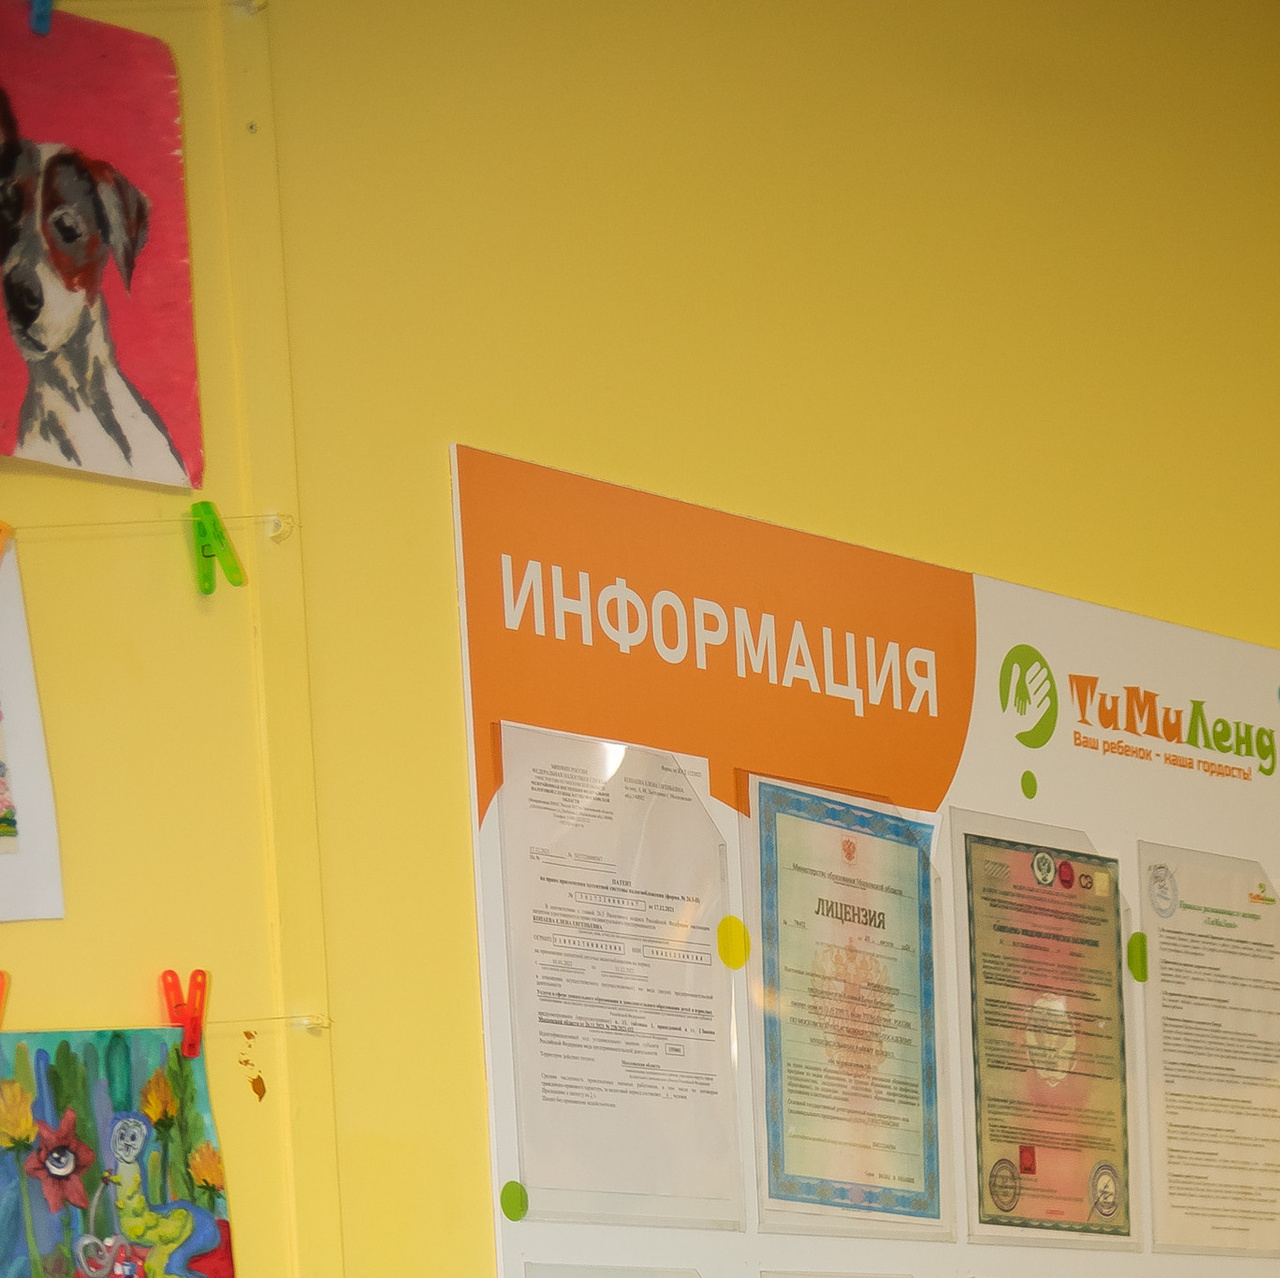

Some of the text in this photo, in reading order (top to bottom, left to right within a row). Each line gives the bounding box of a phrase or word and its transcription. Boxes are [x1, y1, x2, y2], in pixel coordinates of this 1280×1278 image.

[501, 553, 938, 717] ИНФОРМАЦИЯ
[1068, 673, 1277, 776] ТиМиЛенд
[1073, 730, 1099, 751] Ваш
[1102, 740, 1152, 761] ребенок
[1164, 752, 1194, 770] наша
[1197, 760, 1252, 782] гордость!
[815, 897, 886, 930] ЛИЦЕНЗИЯ
